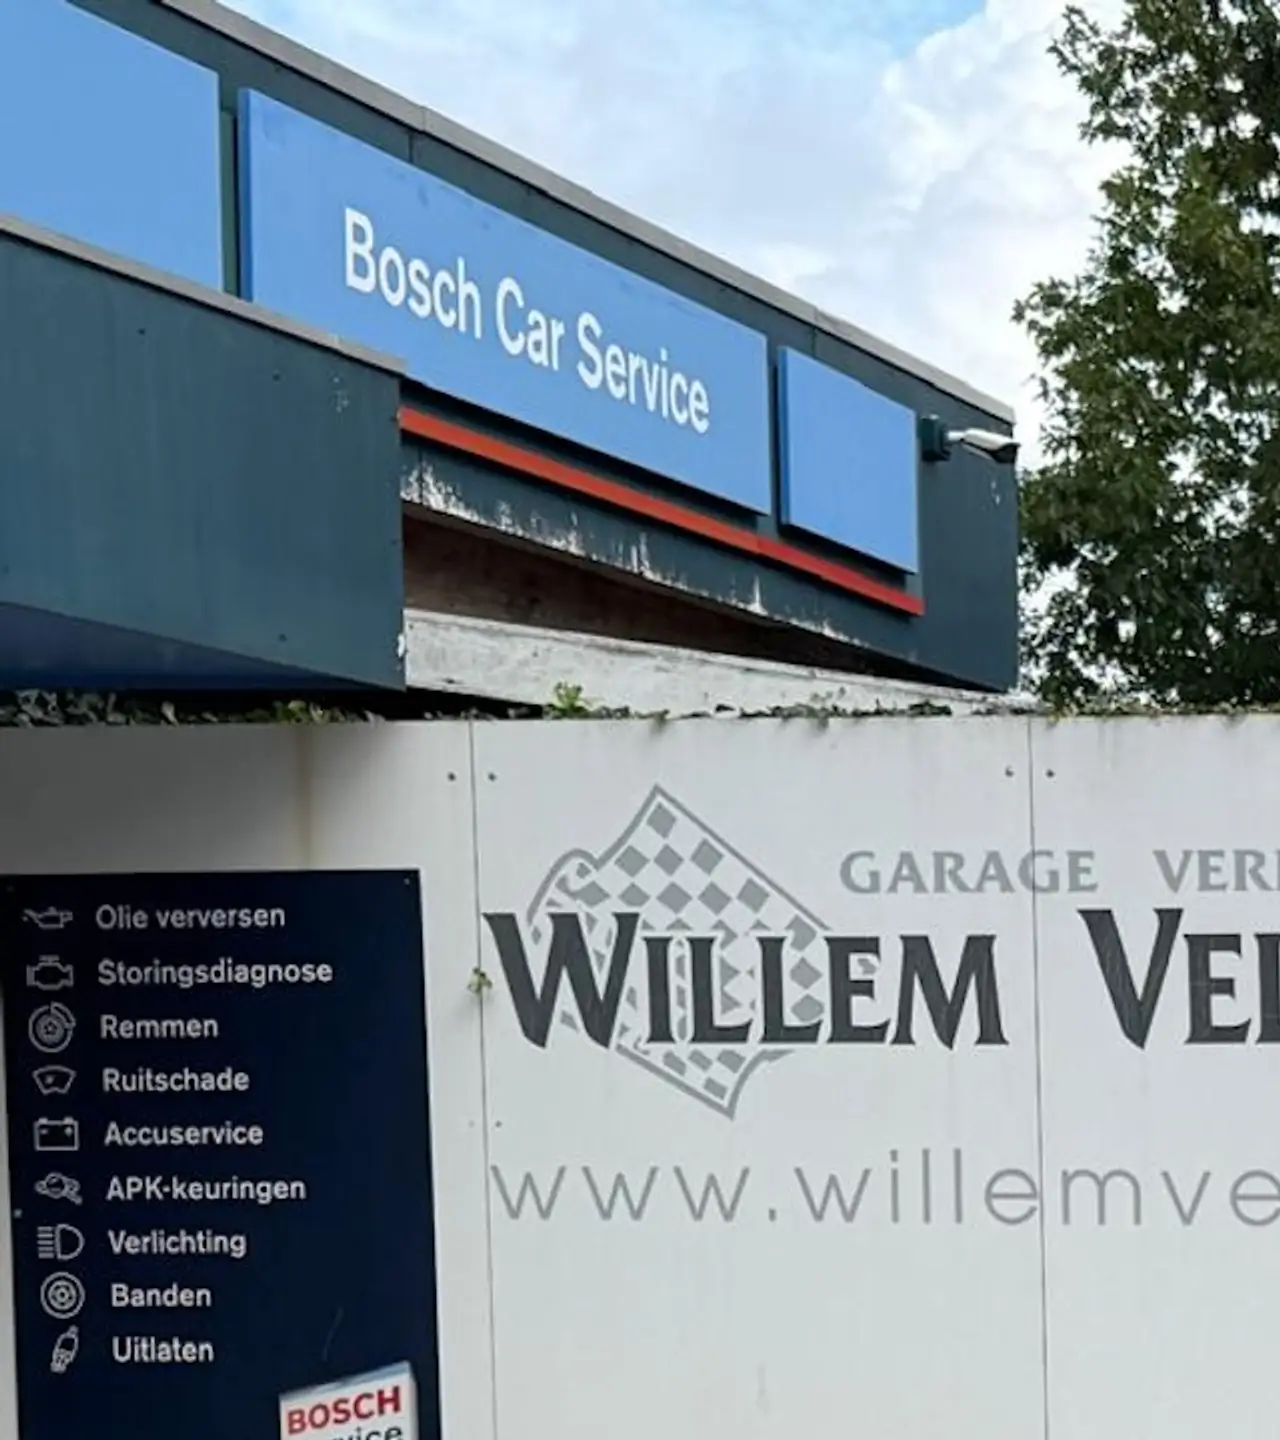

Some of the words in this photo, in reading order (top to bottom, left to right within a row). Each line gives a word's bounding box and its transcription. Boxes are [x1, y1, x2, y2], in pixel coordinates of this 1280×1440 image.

[345, 207, 482, 339] Bosch
[496, 277, 565, 371] Car
[577, 311, 710, 434] Service
[840, 849, 1099, 895] GARAGE
[95, 904, 148, 929] Olie
[156, 906, 286, 929] verversen
[98, 958, 334, 989] Storingsdiagnose
[483, 912, 1008, 1051] WILLEM
[100, 1015, 219, 1038] Remmen
[102, 1067, 250, 1093] Ruitschade
[104, 1122, 264, 1146] Accuservice
[106, 1176, 306, 1204] APK-keuringen
[107, 1229, 247, 1259] Verlichting
[111, 1284, 211, 1307] Banden
[112, 1337, 214, 1363] Uitlaten
[287, 1385, 401, 1436] BOSCH
